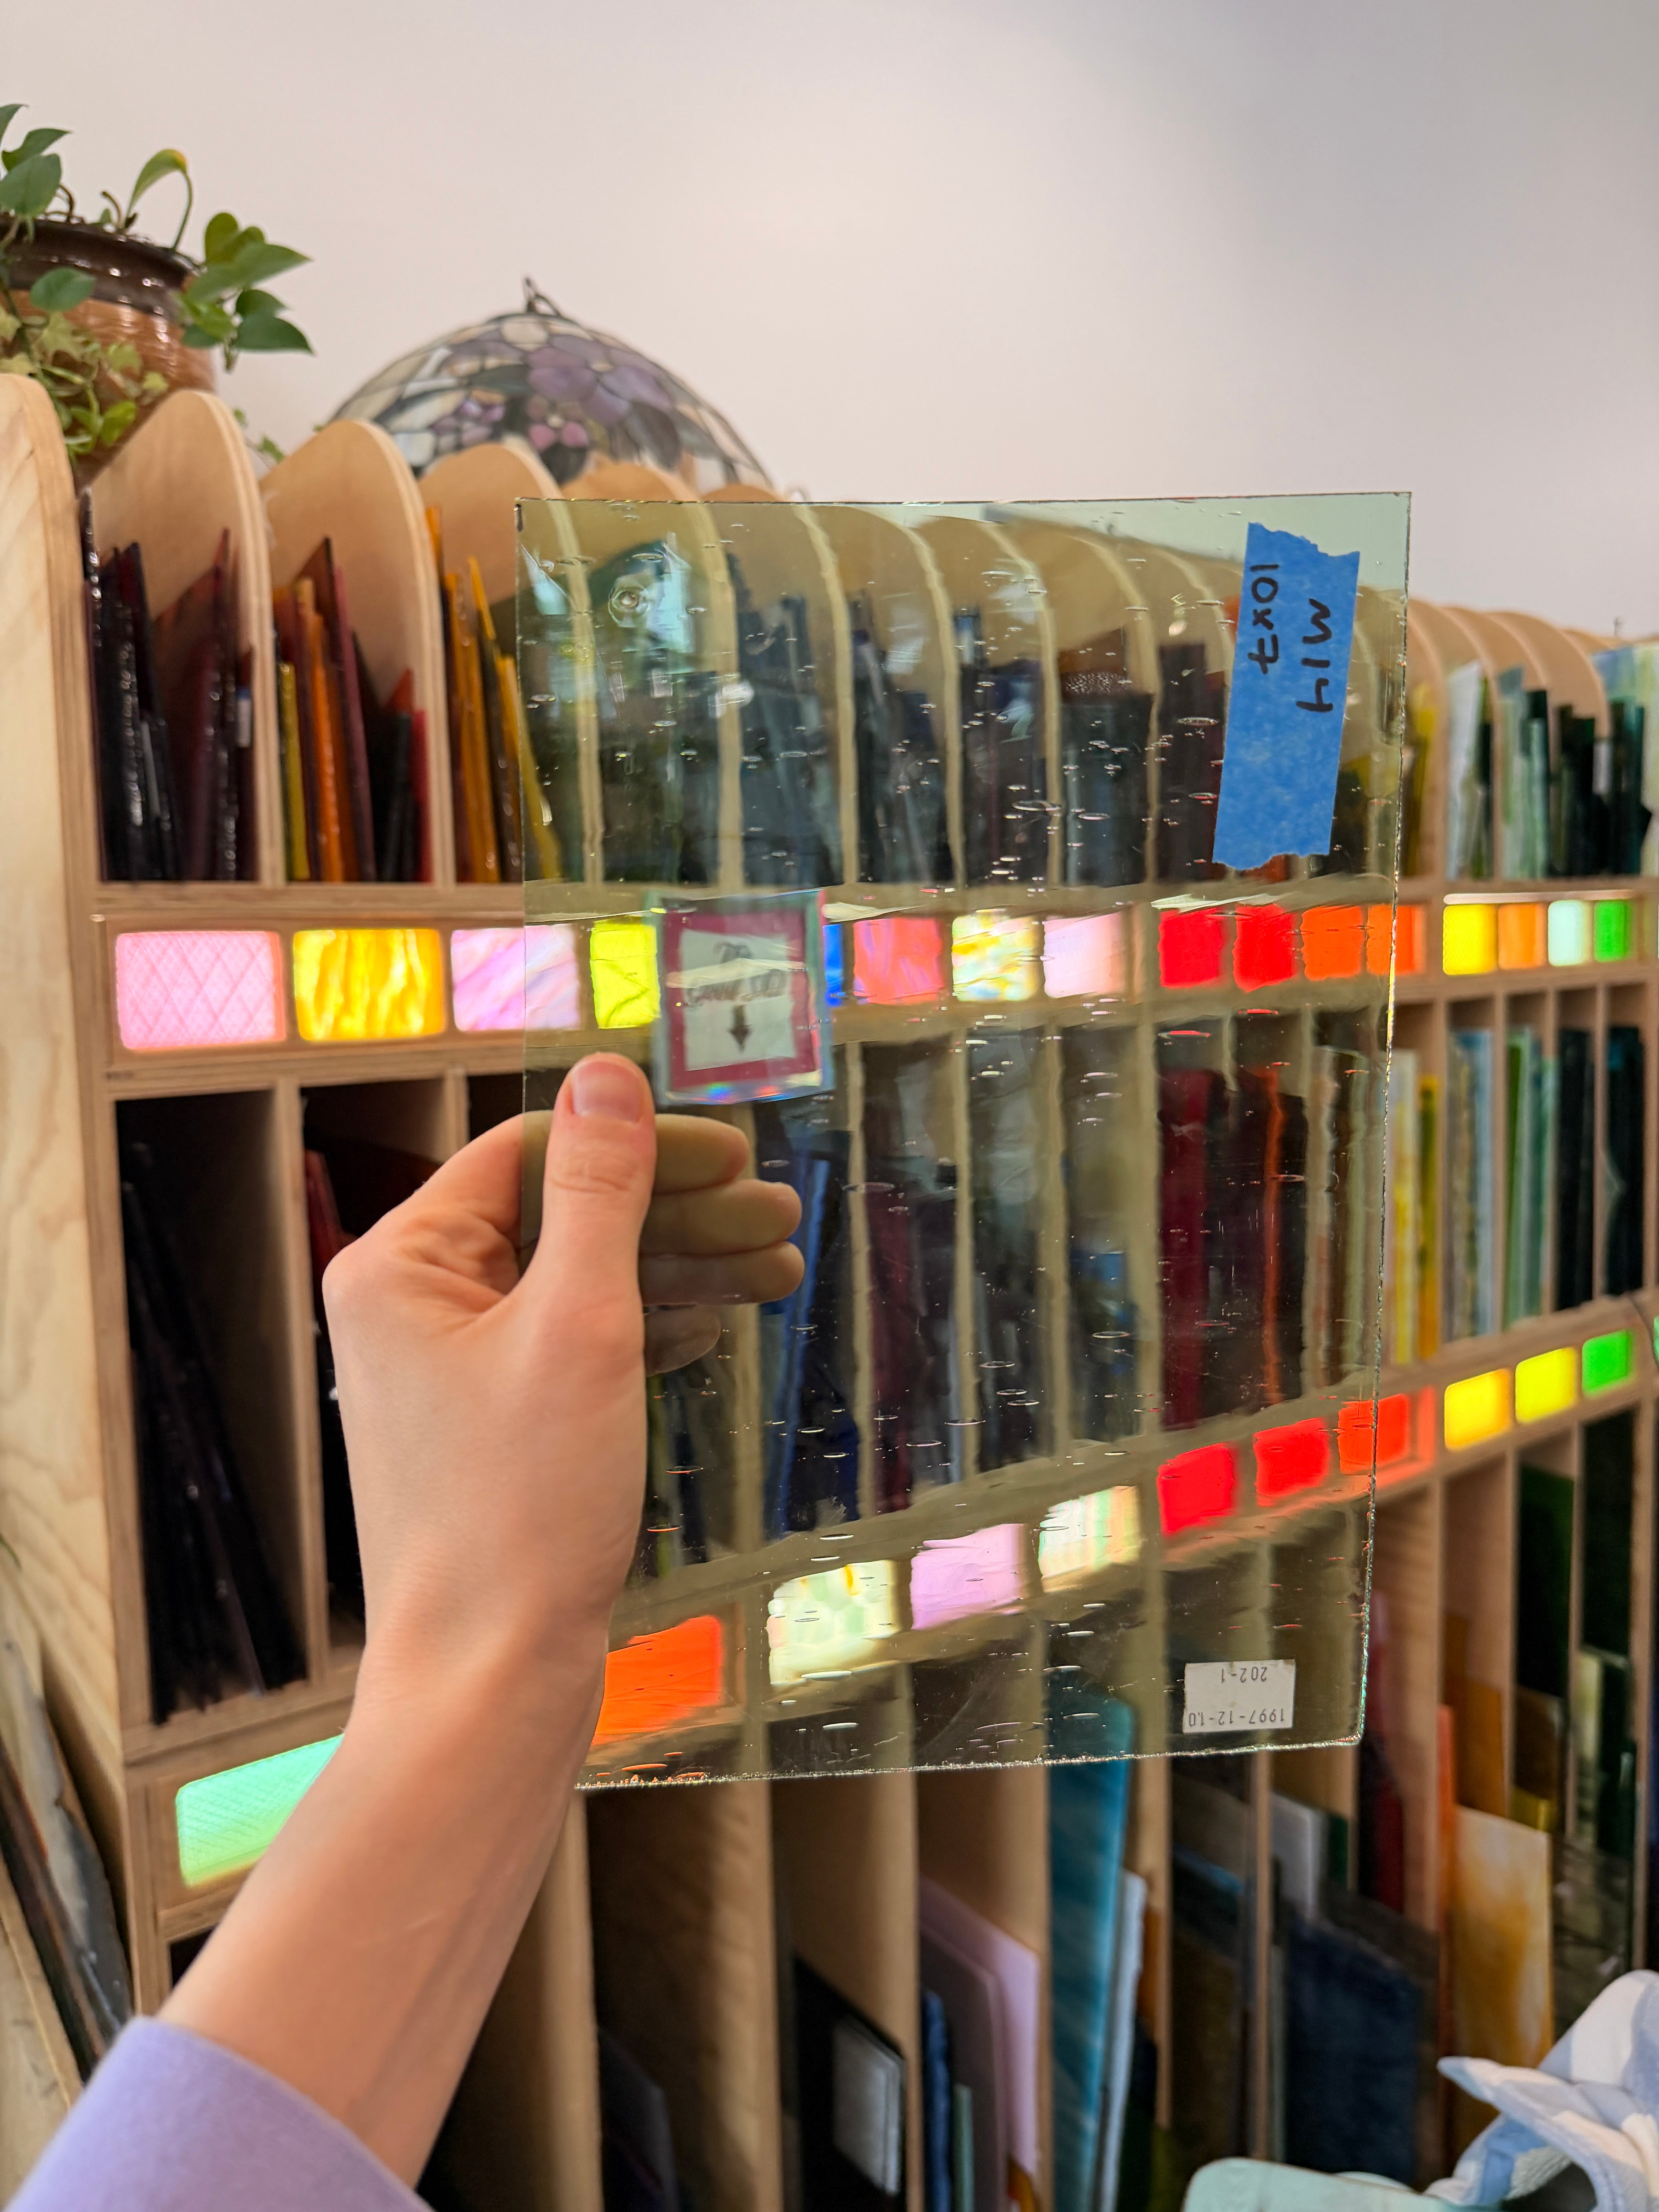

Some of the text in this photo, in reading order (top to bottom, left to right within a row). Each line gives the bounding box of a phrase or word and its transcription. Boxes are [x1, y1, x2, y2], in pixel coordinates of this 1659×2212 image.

[1247, 563, 1280, 675] 10x7
[1295, 598, 1333, 713] M14
[1221, 1666, 1267, 1683] 202-1
